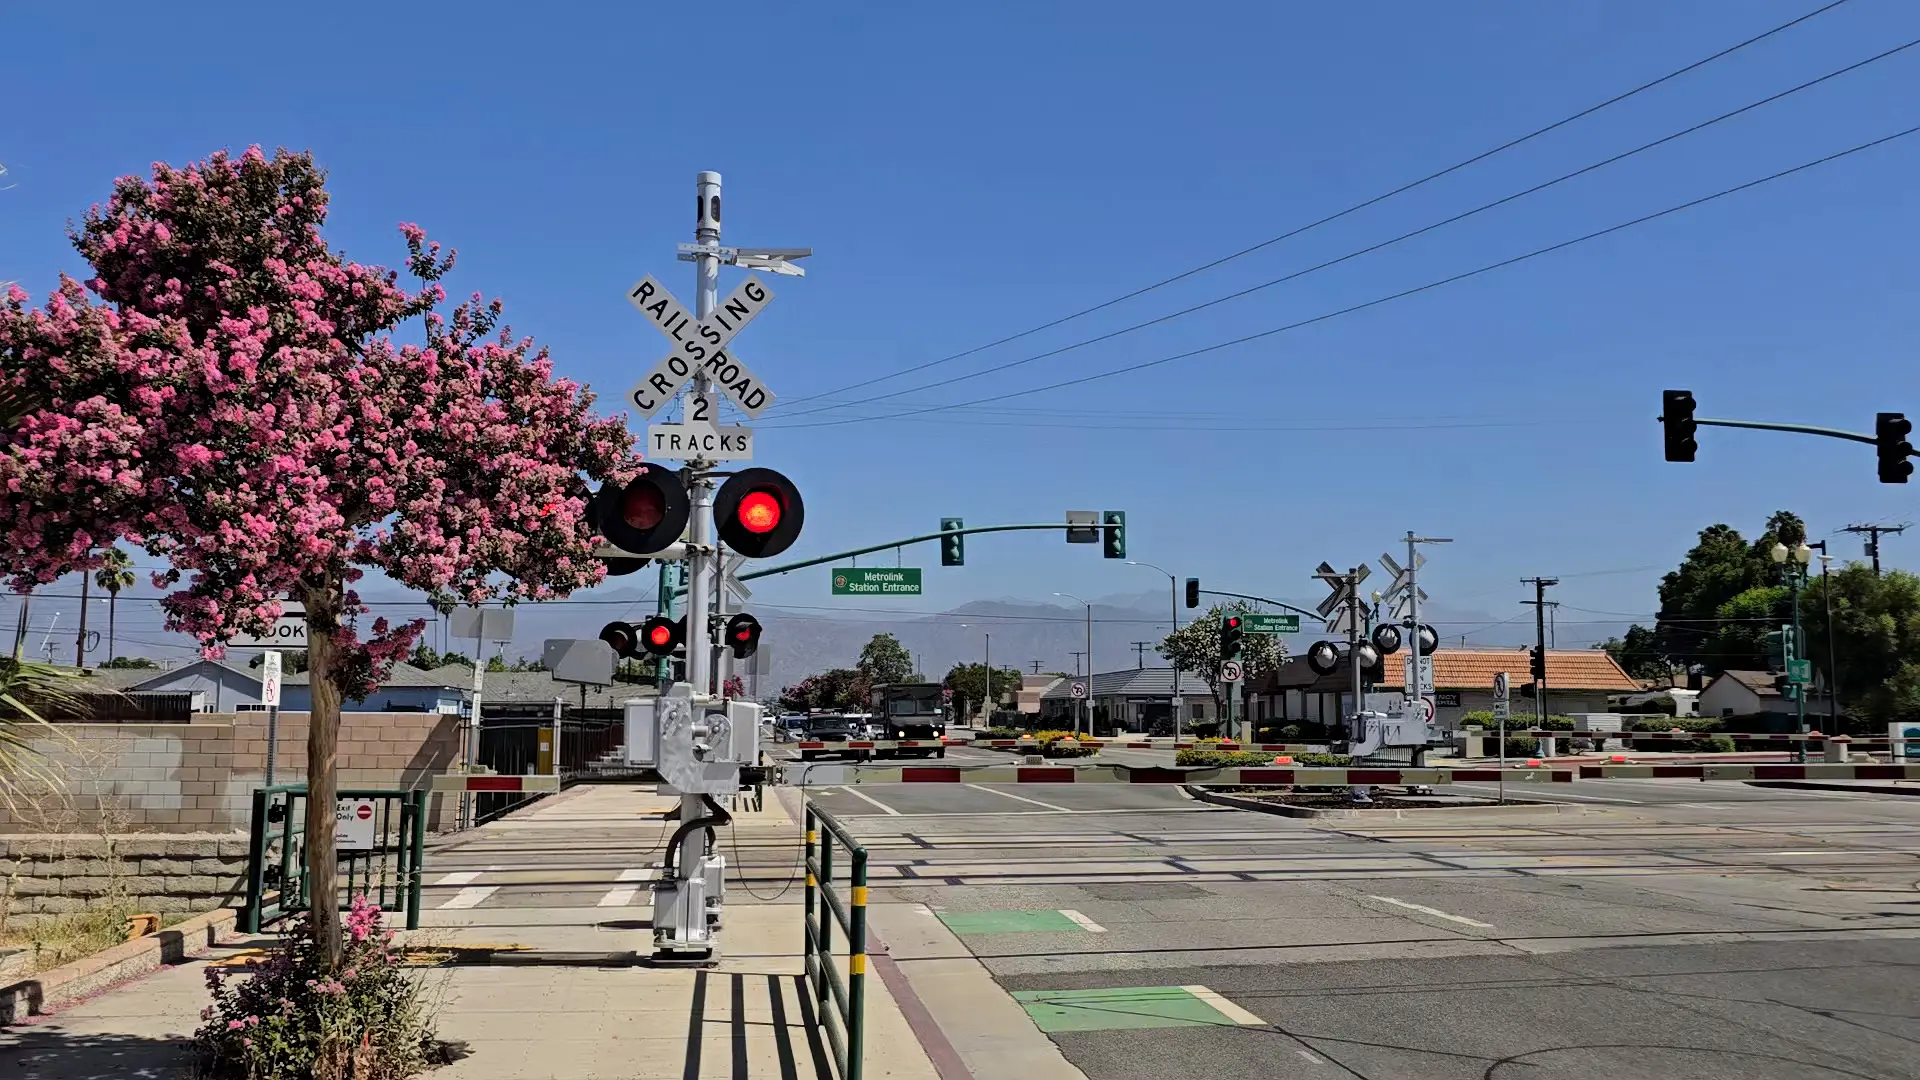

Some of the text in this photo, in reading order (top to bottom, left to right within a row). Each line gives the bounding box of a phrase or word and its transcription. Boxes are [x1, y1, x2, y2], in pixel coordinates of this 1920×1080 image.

[633, 282, 765, 410] CROSSING
[692, 398, 709, 421] 2
[654, 433, 748, 452] TRACKS
[864, 572, 904, 581] Metrolink
[849, 582, 920, 592] Station Entrance
[336, 803, 351, 811] Exit
[336, 812, 354, 822] Only
